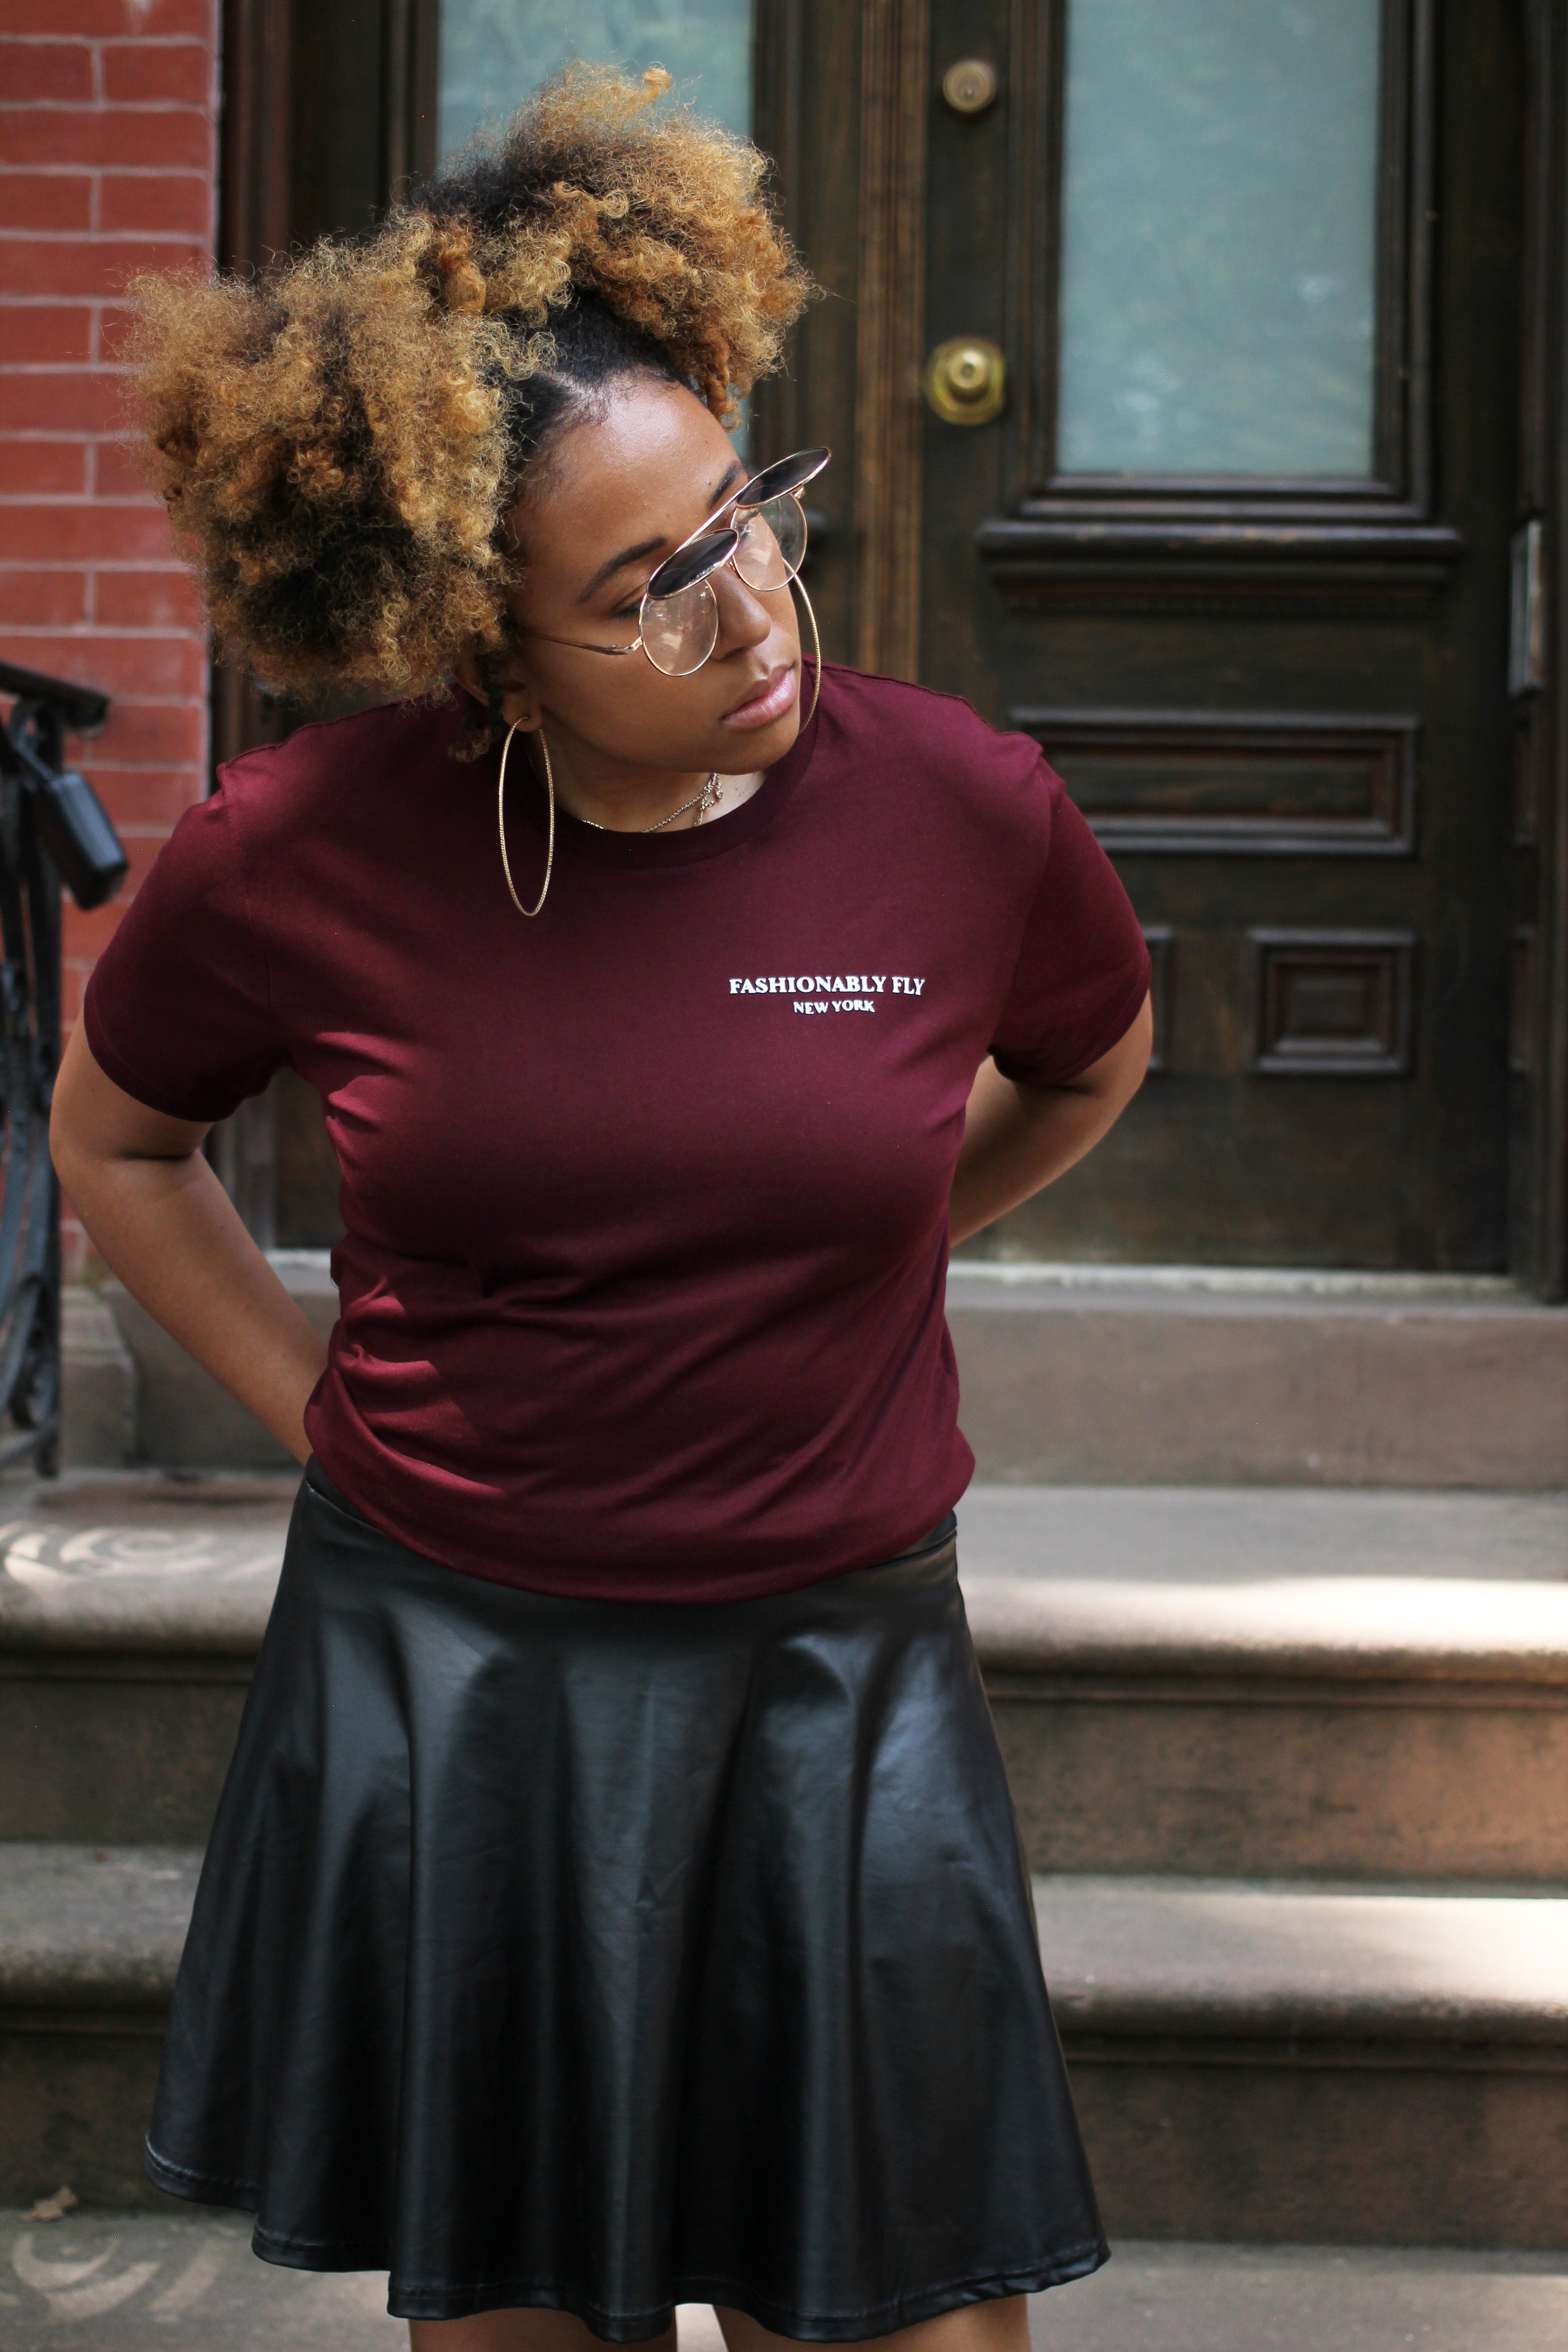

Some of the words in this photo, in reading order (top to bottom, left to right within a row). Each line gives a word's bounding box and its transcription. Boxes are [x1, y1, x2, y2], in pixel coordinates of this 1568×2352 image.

[729, 975, 887, 994] FASHIONABLY
[891, 976, 925, 995] FLY
[793, 1001, 829, 1014] NEW
[831, 1000, 875, 1013] YORK
